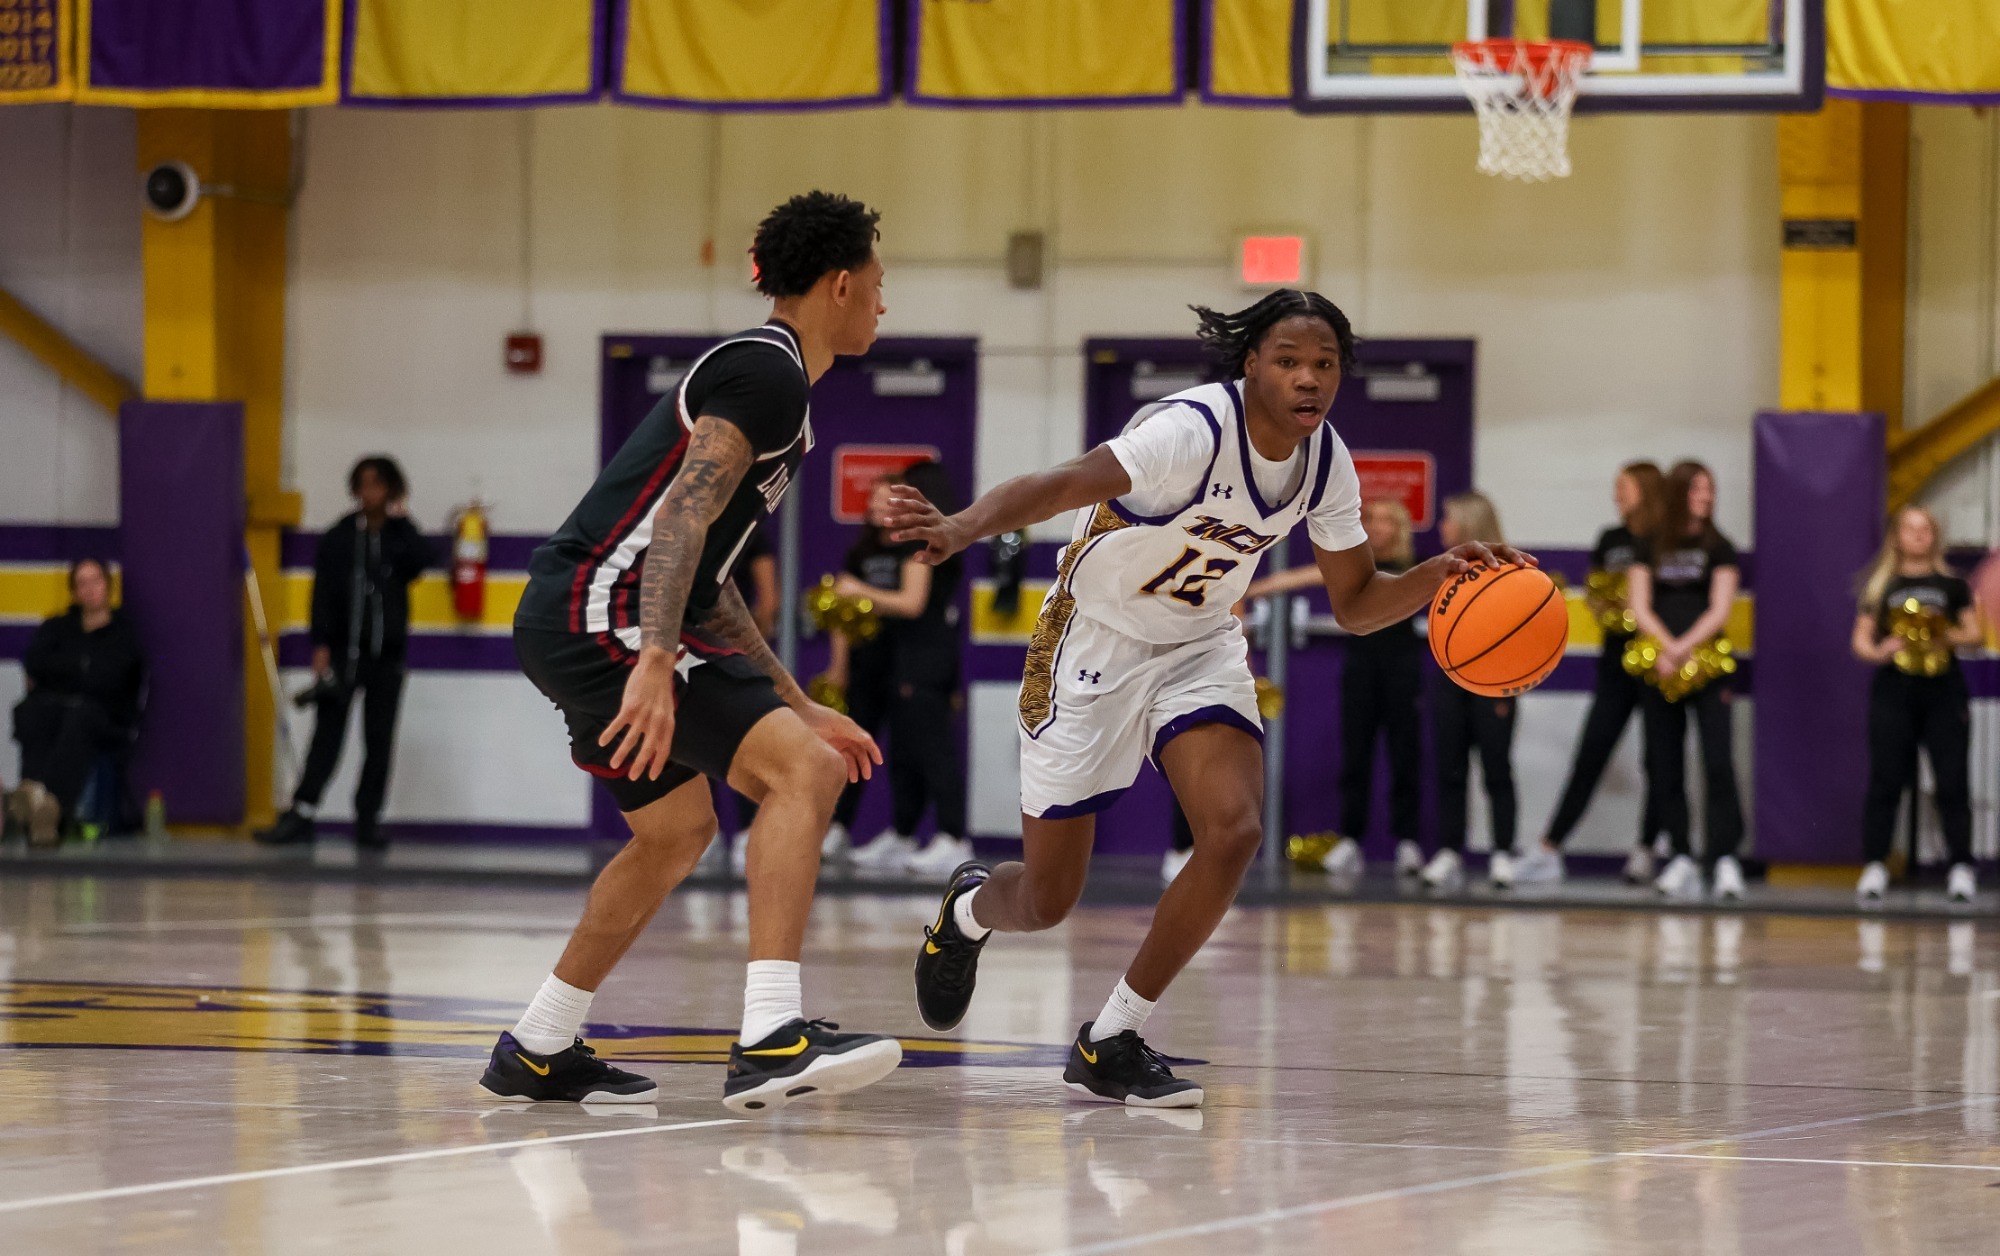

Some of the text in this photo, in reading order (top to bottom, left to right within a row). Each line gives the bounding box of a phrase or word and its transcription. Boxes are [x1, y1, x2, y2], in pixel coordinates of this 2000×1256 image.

[0, 10, 53, 34] 014
[0, 36, 52, 60] 017
[1138, 543, 1240, 607] 12
[1437, 557, 1508, 616] ilson
